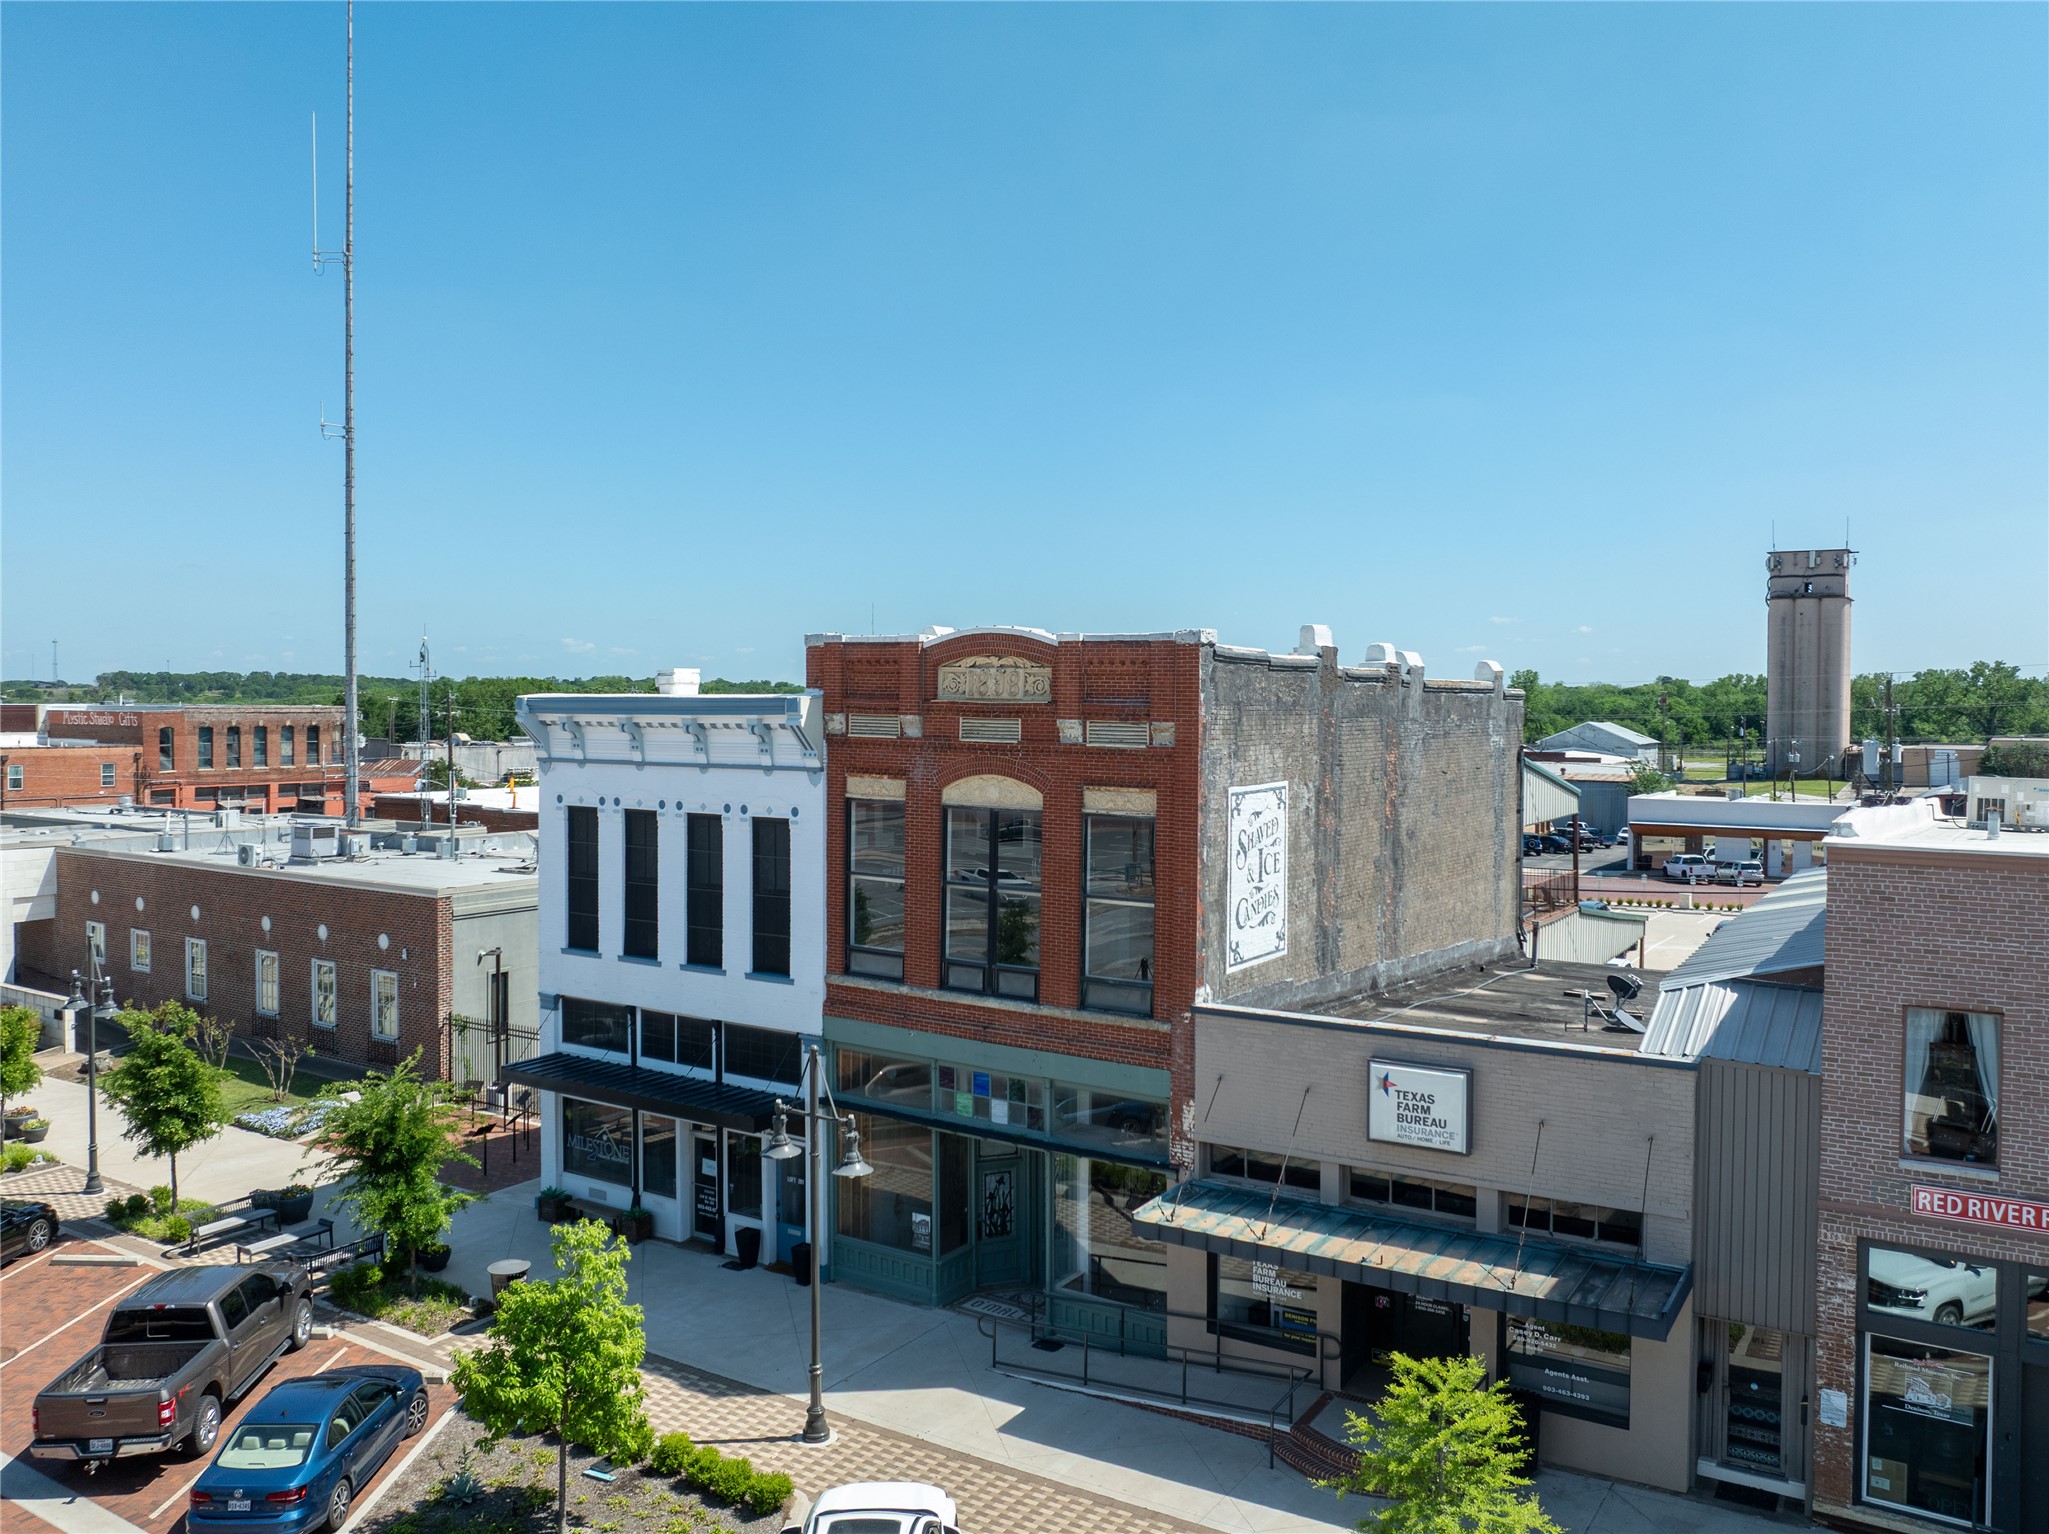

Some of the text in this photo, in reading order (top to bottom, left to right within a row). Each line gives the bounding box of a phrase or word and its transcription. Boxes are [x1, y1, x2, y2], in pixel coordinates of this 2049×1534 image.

[62, 712, 138, 726] Mystic Studio Gifts
[1257, 848, 1280, 883] ICE
[1394, 1090, 1435, 1104] TEXAS
[1396, 1102, 1431, 1116] FARM
[1396, 1112, 1446, 1129] BUREAU
[1396, 1124, 1456, 1140] INSURANCE
[567, 1132, 630, 1160] MILESTONE
[1918, 1192, 1962, 1214] RED
[1968, 1198, 2036, 1226] RIVER
[1252, 1266, 1276, 1278] FARM
[1252, 1275, 1286, 1288] BUREAU
[1252, 1282, 1302, 1299] INSURANCE
[1509, 1326, 1532, 1337] Casey
[1544, 1333, 1562, 1342] Carr
[1525, 1322, 1545, 1331] Agent
[1544, 1368, 1590, 1383] Agents Asst.
[1543, 1385, 1590, 1400] 903-463-4393
